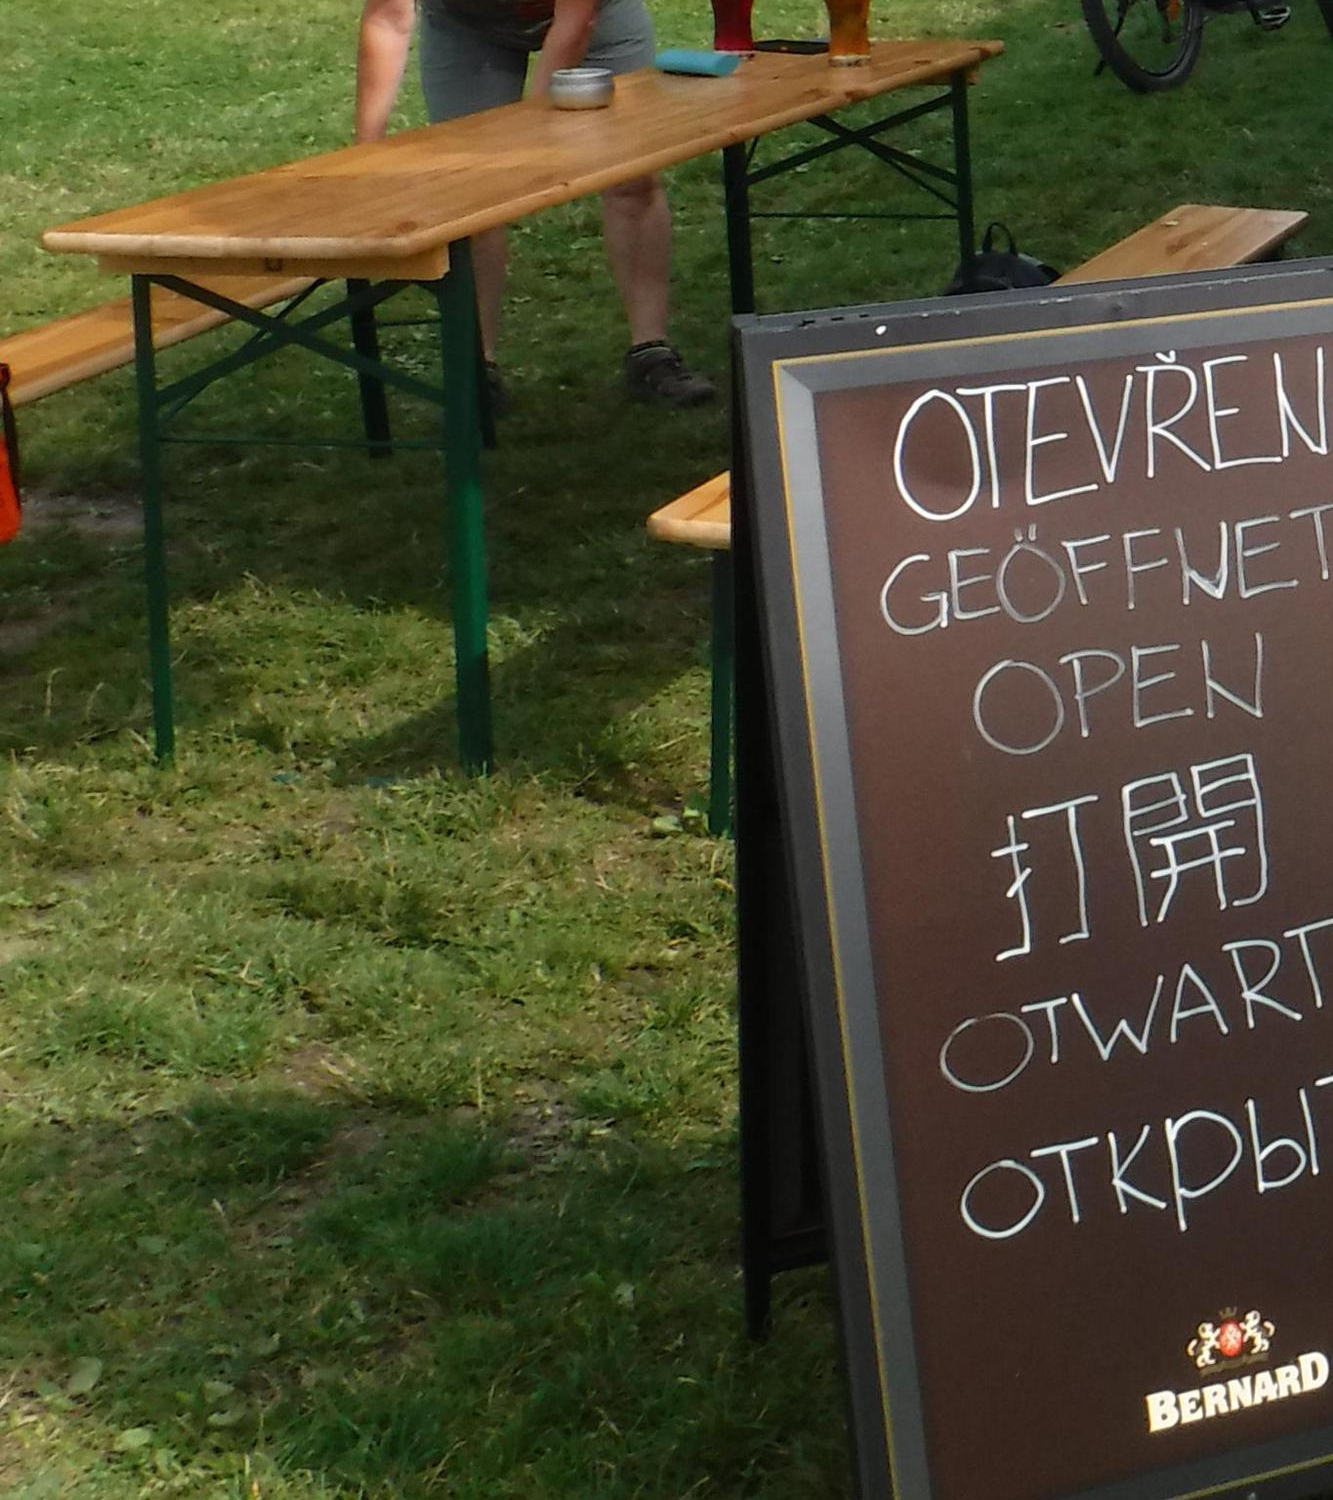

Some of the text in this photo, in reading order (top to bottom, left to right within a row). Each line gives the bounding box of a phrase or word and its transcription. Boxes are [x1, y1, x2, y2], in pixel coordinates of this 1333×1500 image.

[973, 631, 1264, 755] OPEN
[991, 753, 1268, 961] 打開
[1145, 1351, 1330, 1433] BERNARD
